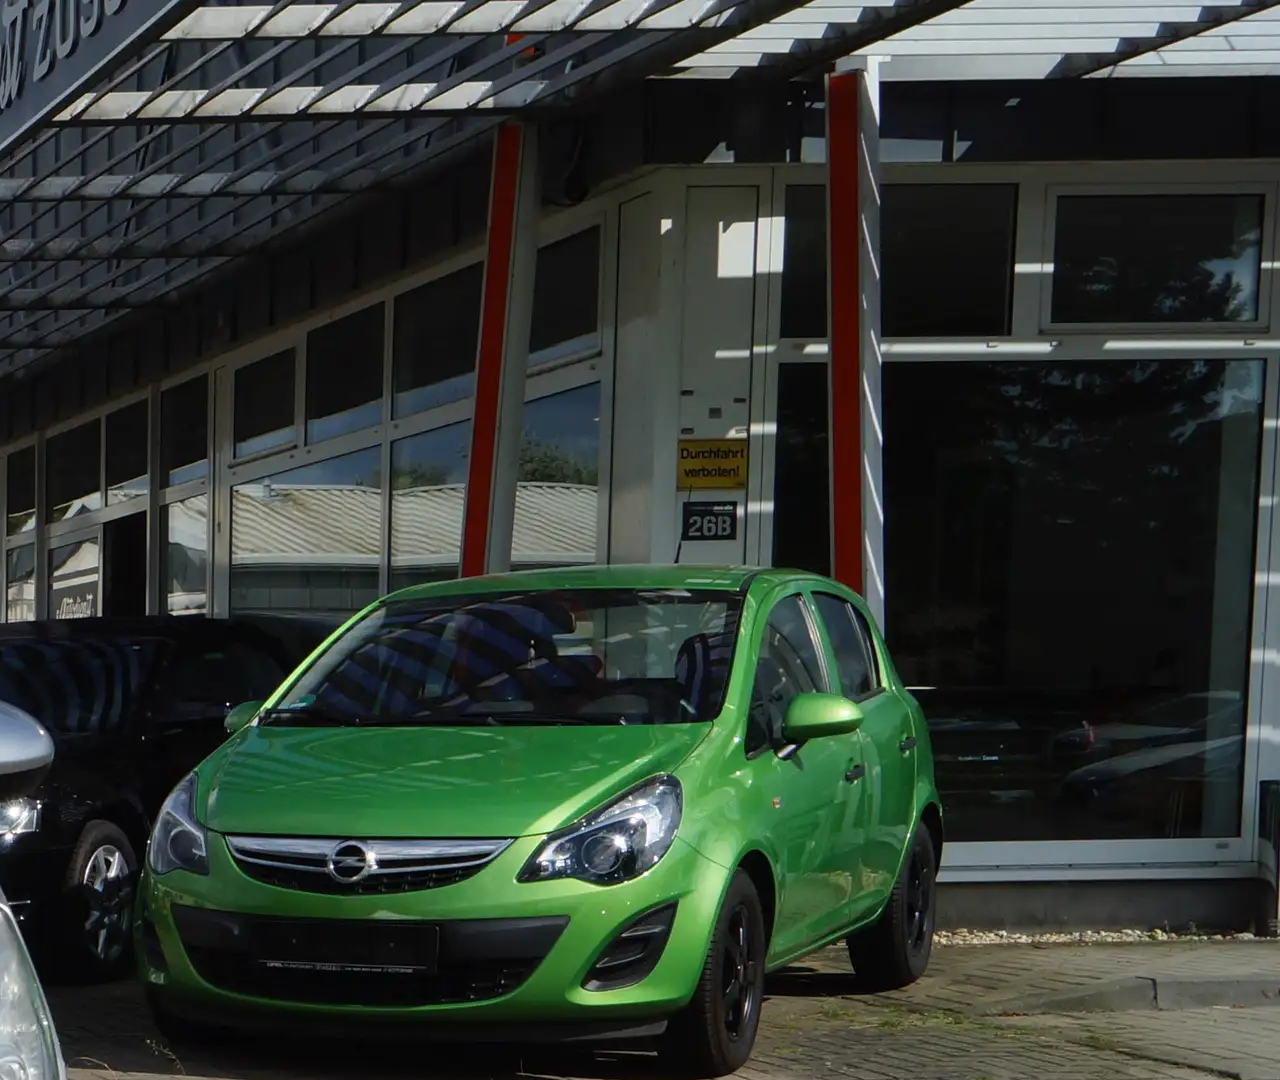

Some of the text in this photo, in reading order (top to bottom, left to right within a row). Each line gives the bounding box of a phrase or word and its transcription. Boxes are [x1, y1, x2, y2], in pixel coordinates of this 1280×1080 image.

[680, 447, 744, 460] Durchfahrt
[683, 465, 740, 477] verboten!
[688, 515, 732, 537] 26B
